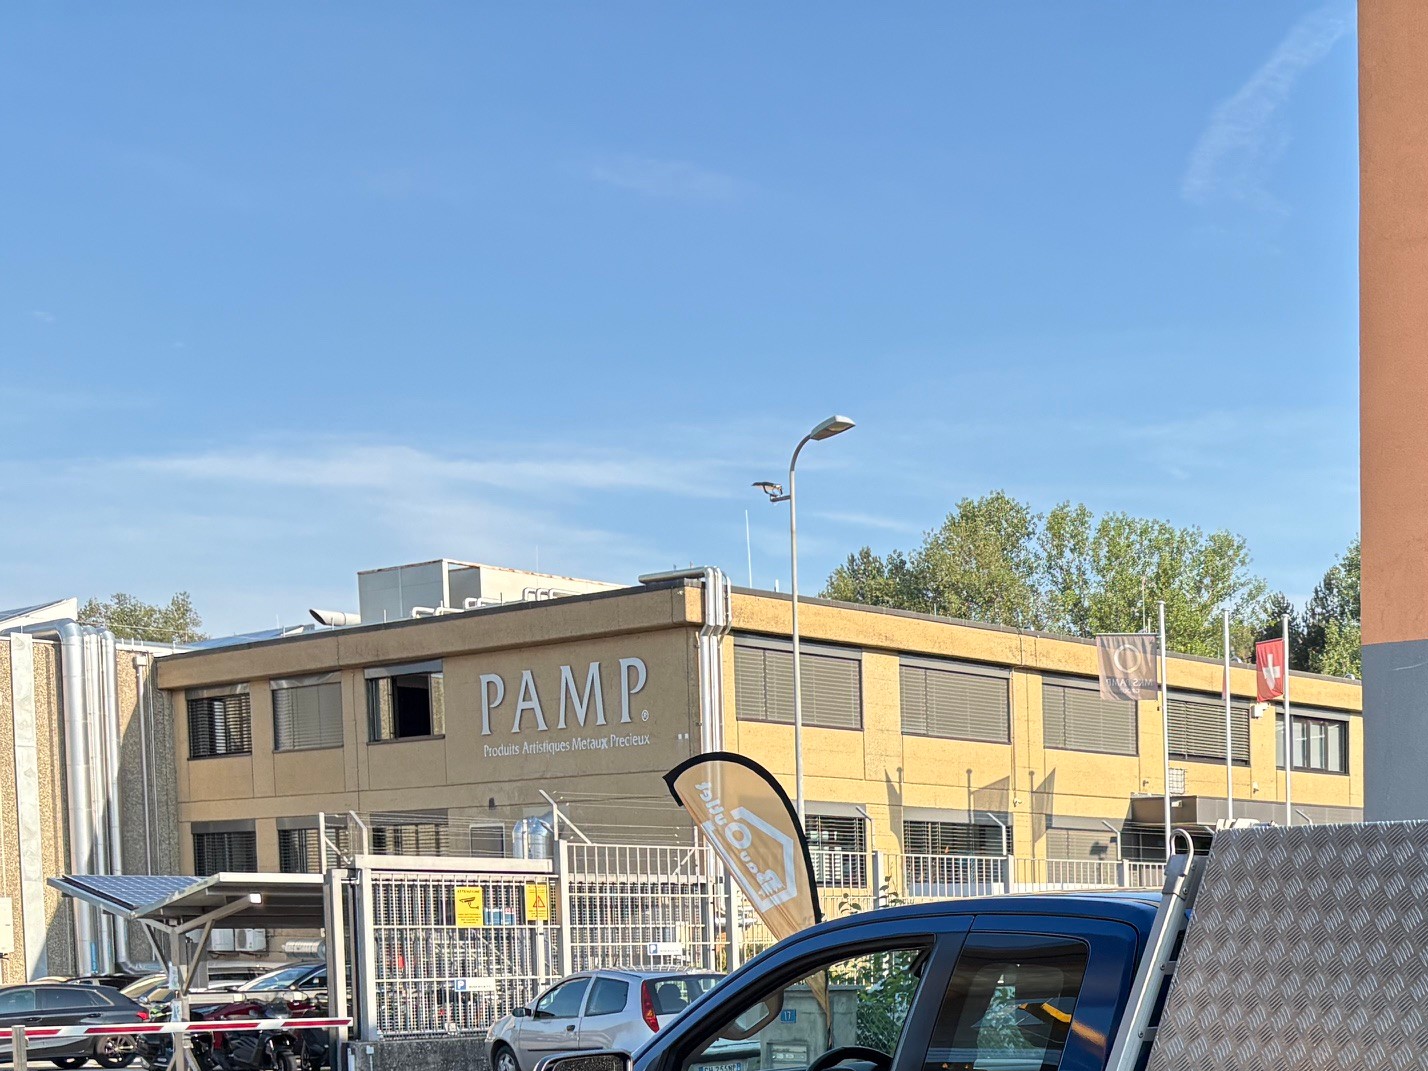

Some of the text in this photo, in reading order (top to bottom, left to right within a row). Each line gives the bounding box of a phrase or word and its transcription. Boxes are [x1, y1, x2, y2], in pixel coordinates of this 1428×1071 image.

[479, 657, 648, 736] PAMP
[483, 733, 650, 757] Produits Artistiques Metaux Precieux
